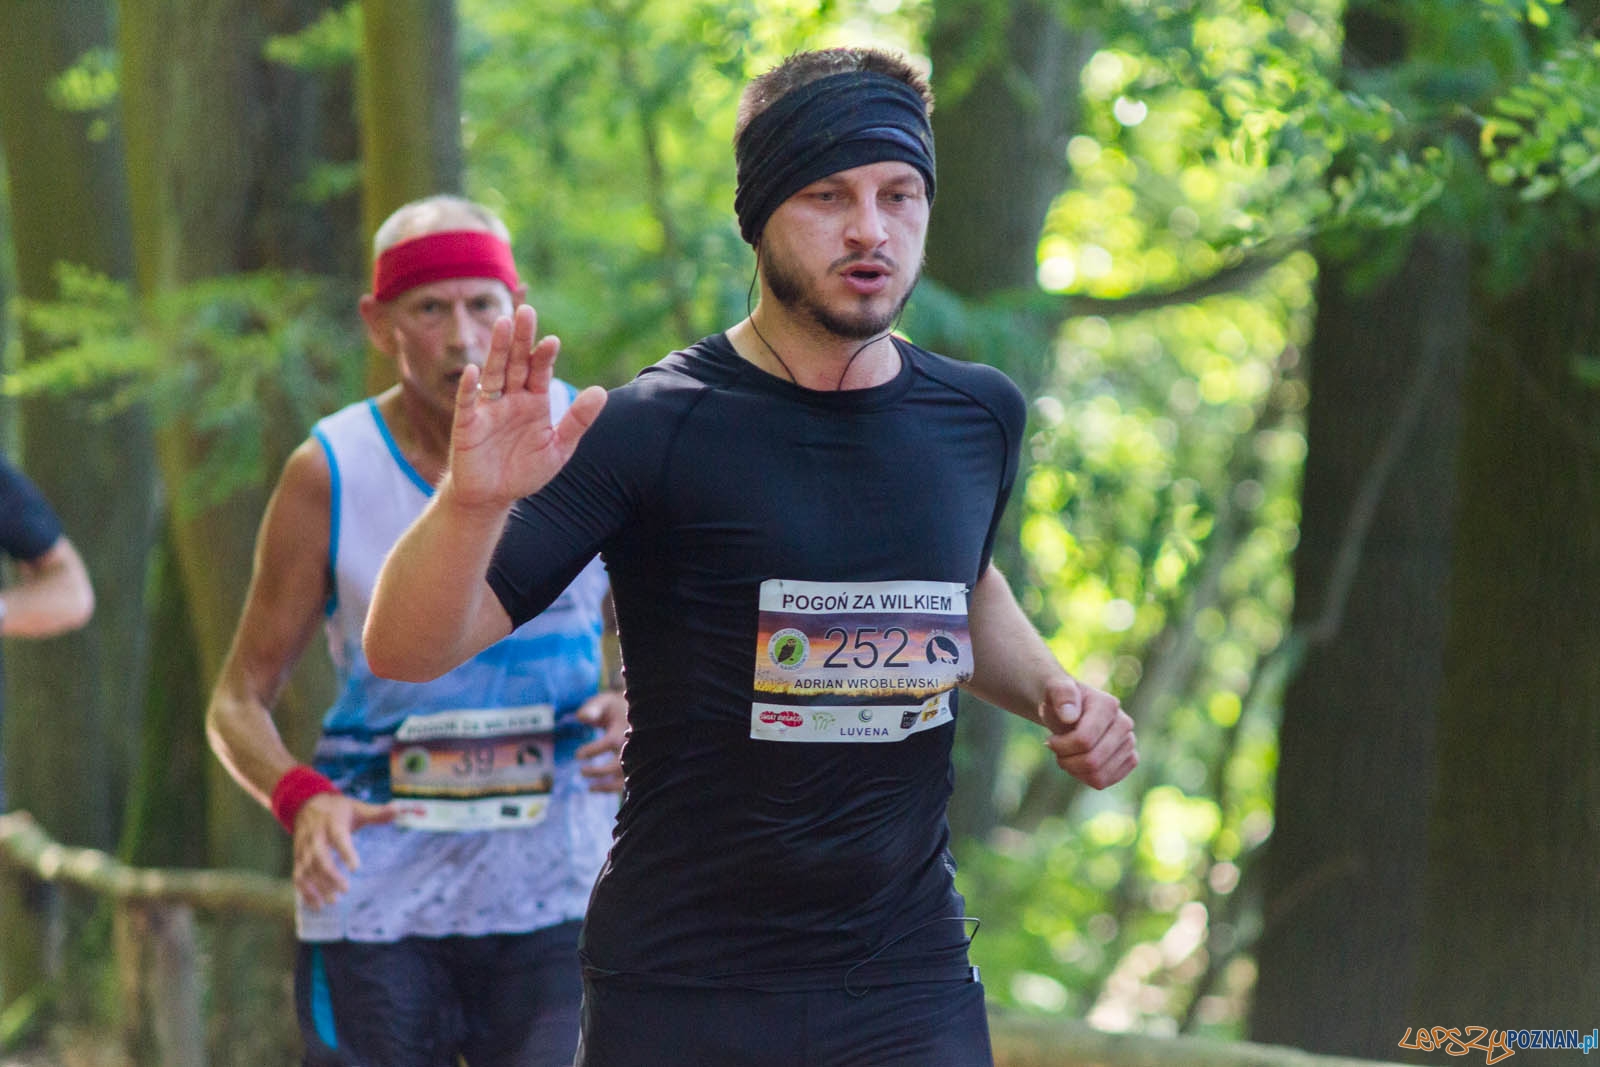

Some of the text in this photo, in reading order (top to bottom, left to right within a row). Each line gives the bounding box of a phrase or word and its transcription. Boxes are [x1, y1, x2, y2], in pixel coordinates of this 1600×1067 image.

[782, 592, 952, 611] POGOŃ ZA WILKIEM
[823, 627, 910, 669] 252
[794, 679, 844, 689] ADRIAN
[840, 728, 889, 736] LUVENA
[454, 748, 496, 778] 39
